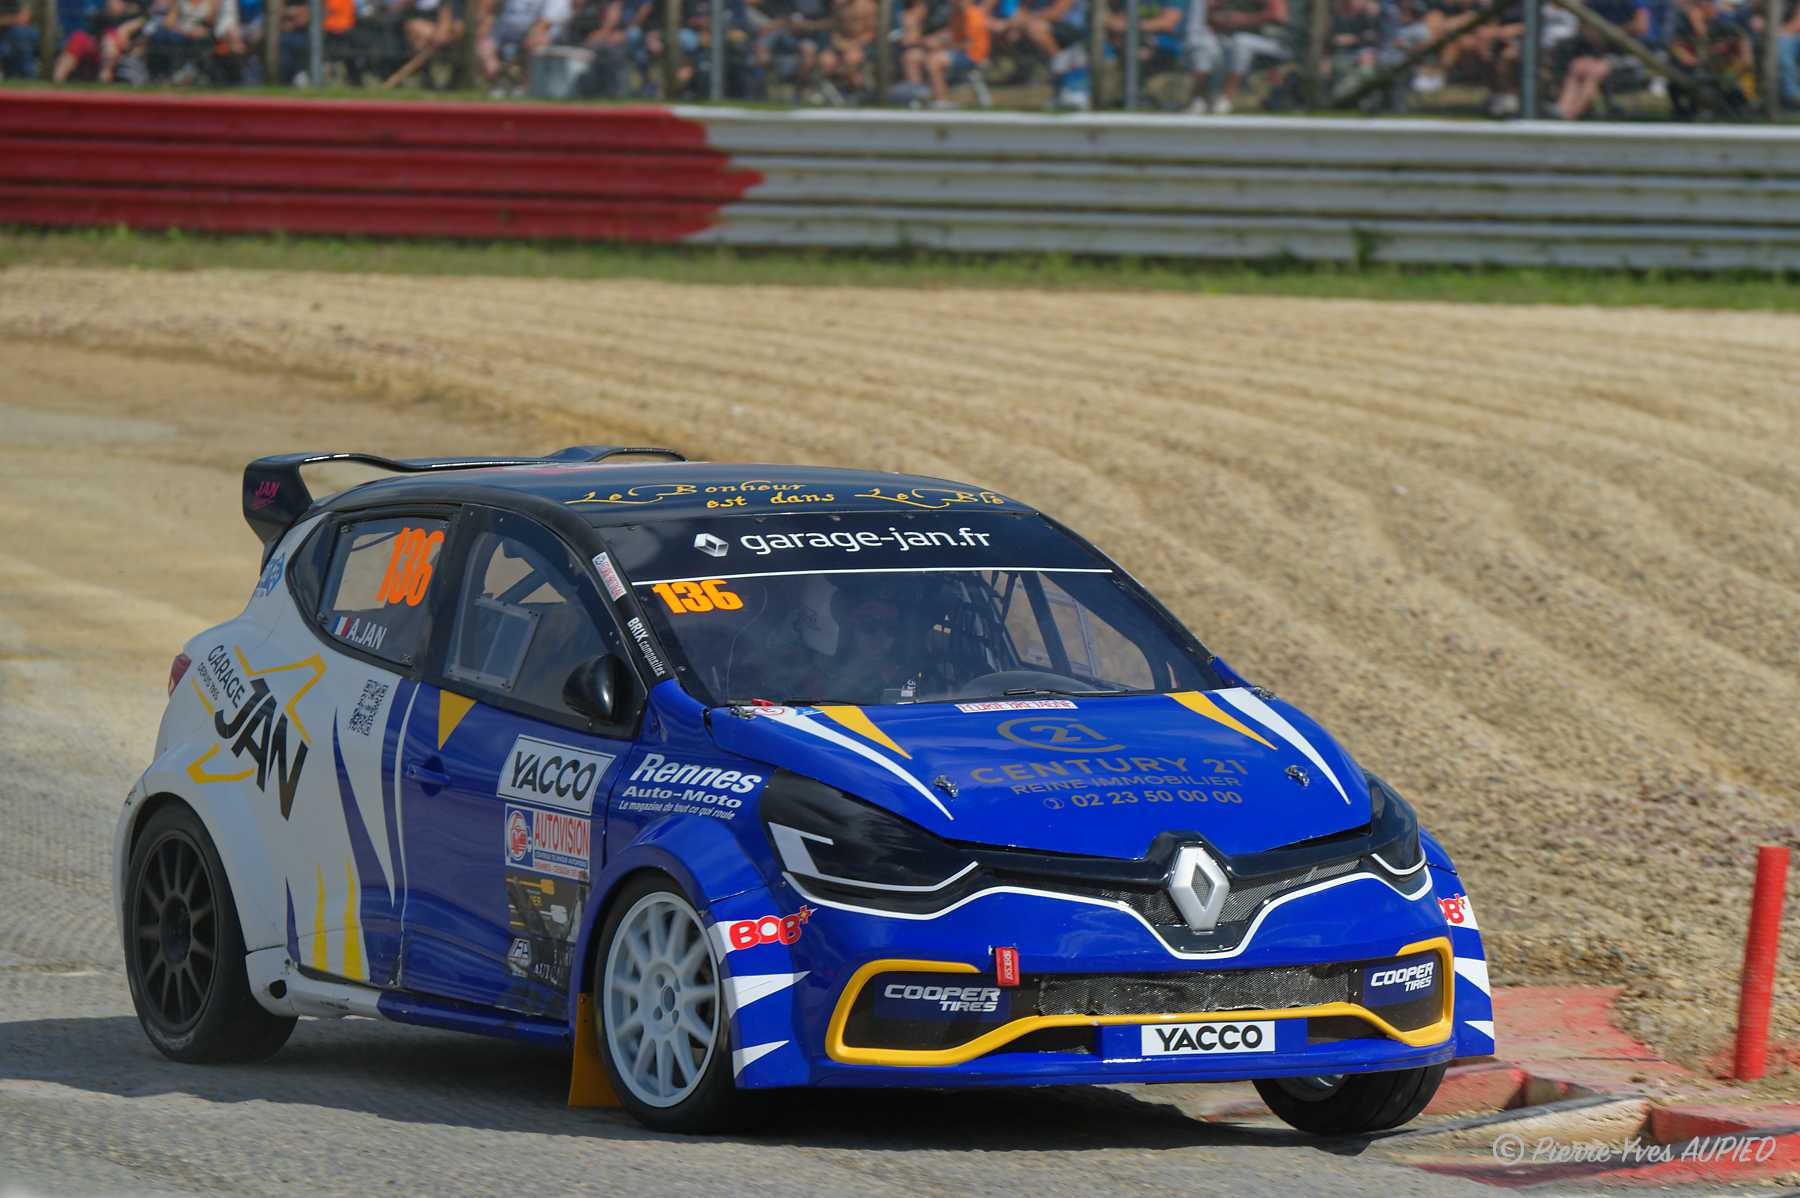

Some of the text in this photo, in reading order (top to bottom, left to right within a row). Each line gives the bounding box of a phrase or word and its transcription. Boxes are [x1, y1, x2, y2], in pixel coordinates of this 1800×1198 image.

[705, 491, 835, 509] est dans
[740, 527, 991, 555] garage-jan.fr
[376, 528, 445, 606] 136
[651, 579, 744, 614] 136
[346, 618, 387, 650] A.JAN
[626, 616, 667, 677] BRIX composites
[207, 644, 246, 709] GARAGE
[1030, 724, 1107, 742] 21
[214, 677, 310, 822] JAN
[511, 751, 597, 801] YACCO
[629, 753, 762, 793] Rennes
[969, 757, 1249, 784] CENTURY 21
[621, 785, 744, 809] Auto-Moto
[1010, 774, 1242, 796] REINE IMMOBILIER
[1071, 789, 1244, 808] 02 23 50 00 00
[535, 811, 589, 857] AUTOVISION
[728, 914, 802, 951] BOB
[1370, 961, 1435, 987] COOPER
[1404, 975, 1433, 992] TIRES
[883, 983, 1001, 1002] COOPER
[938, 1001, 999, 1012] TIRES
[1155, 1024, 1263, 1052] YACCO
